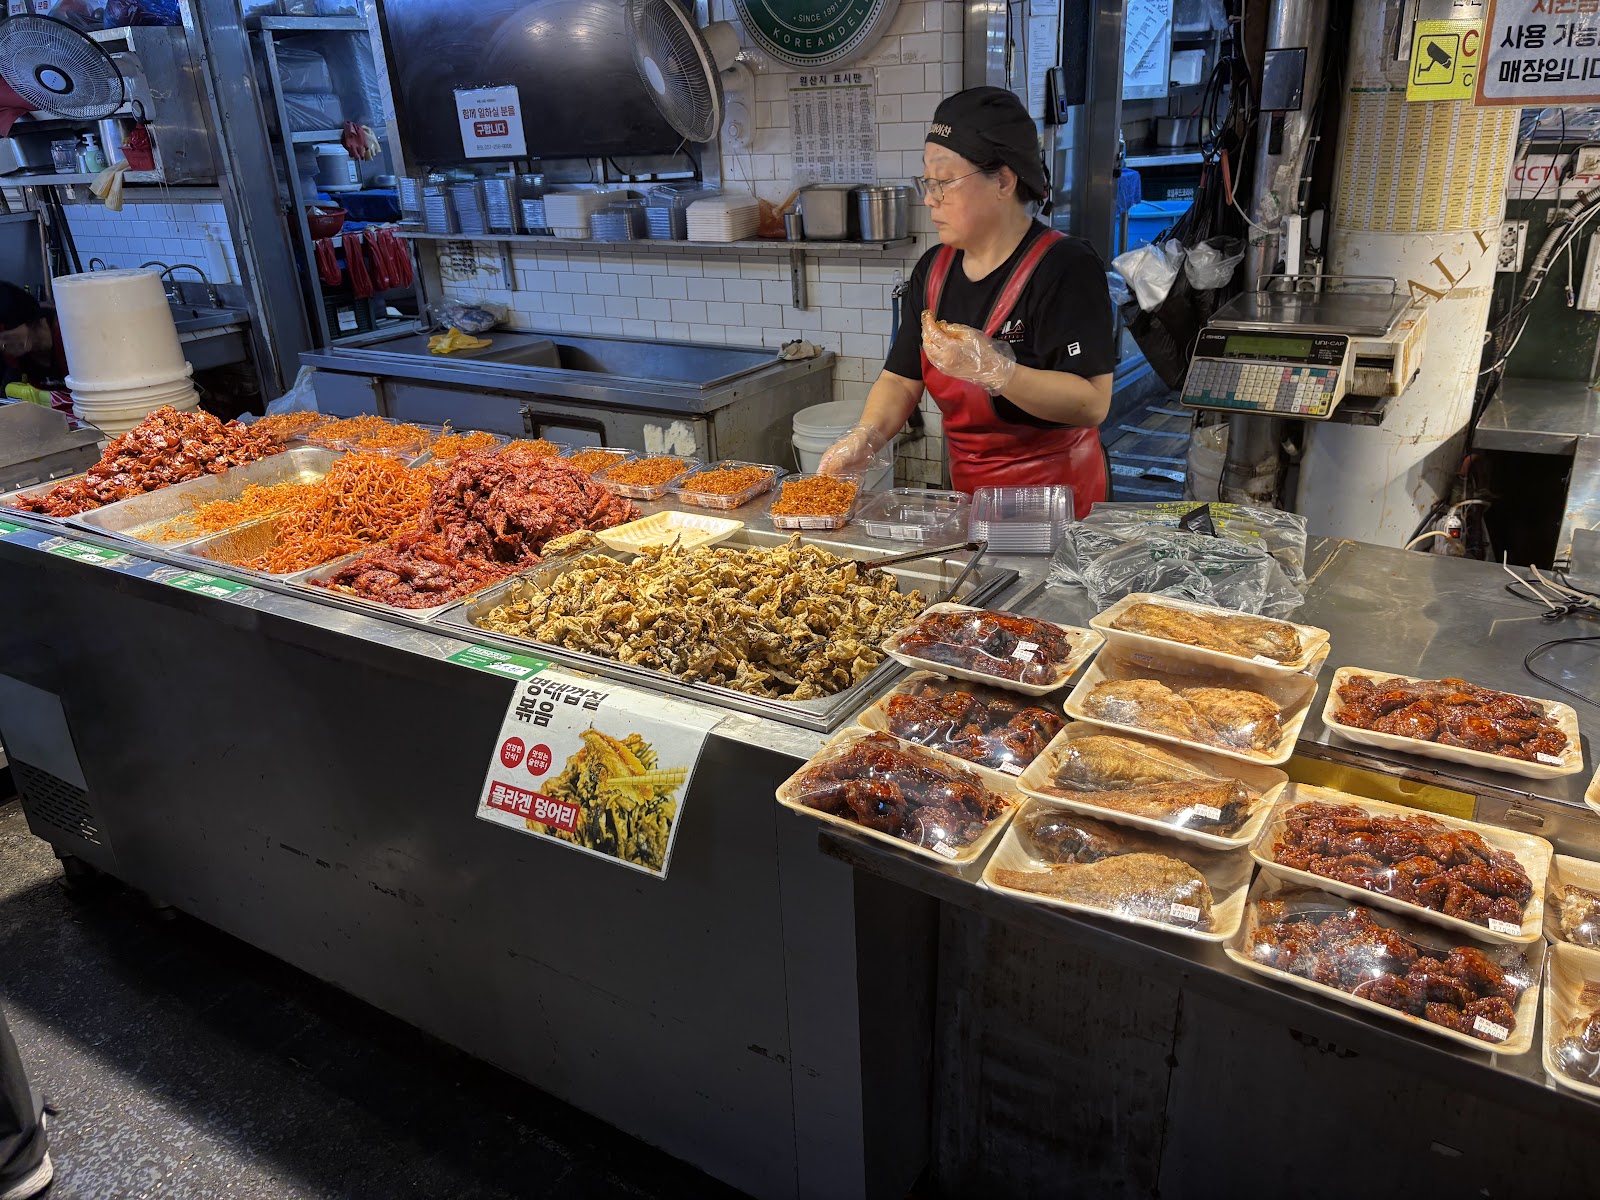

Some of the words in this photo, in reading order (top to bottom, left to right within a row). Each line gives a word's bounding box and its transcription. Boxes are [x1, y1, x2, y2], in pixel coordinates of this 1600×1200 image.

[798, 12, 821, 23] SINCE
[823, 3, 839, 18] 1991
[772, 0, 870, 48] KOREANDEL
[1500, 24, 1547, 49] 사용
[1552, 22, 1600, 47] 가능
[800, 75, 827, 86] 원산지
[833, 73, 862, 83] 표시판
[463, 108, 476, 119] 함께
[478, 106, 499, 118] 일하실
[501, 105, 515, 116] 분을
[476, 122, 506, 135] 구합니다
[527, 676, 610, 711] 명태껍질
[515, 696, 555, 728] 볶음
[506, 743, 522, 754] 건강한
[531, 750, 549, 761] 맛있는
[504, 751, 519, 762] 간식!
[528, 758, 548, 770] 술안주!
[491, 784, 533, 815] 콜라겐
[534, 797, 576, 828] 덩어리
